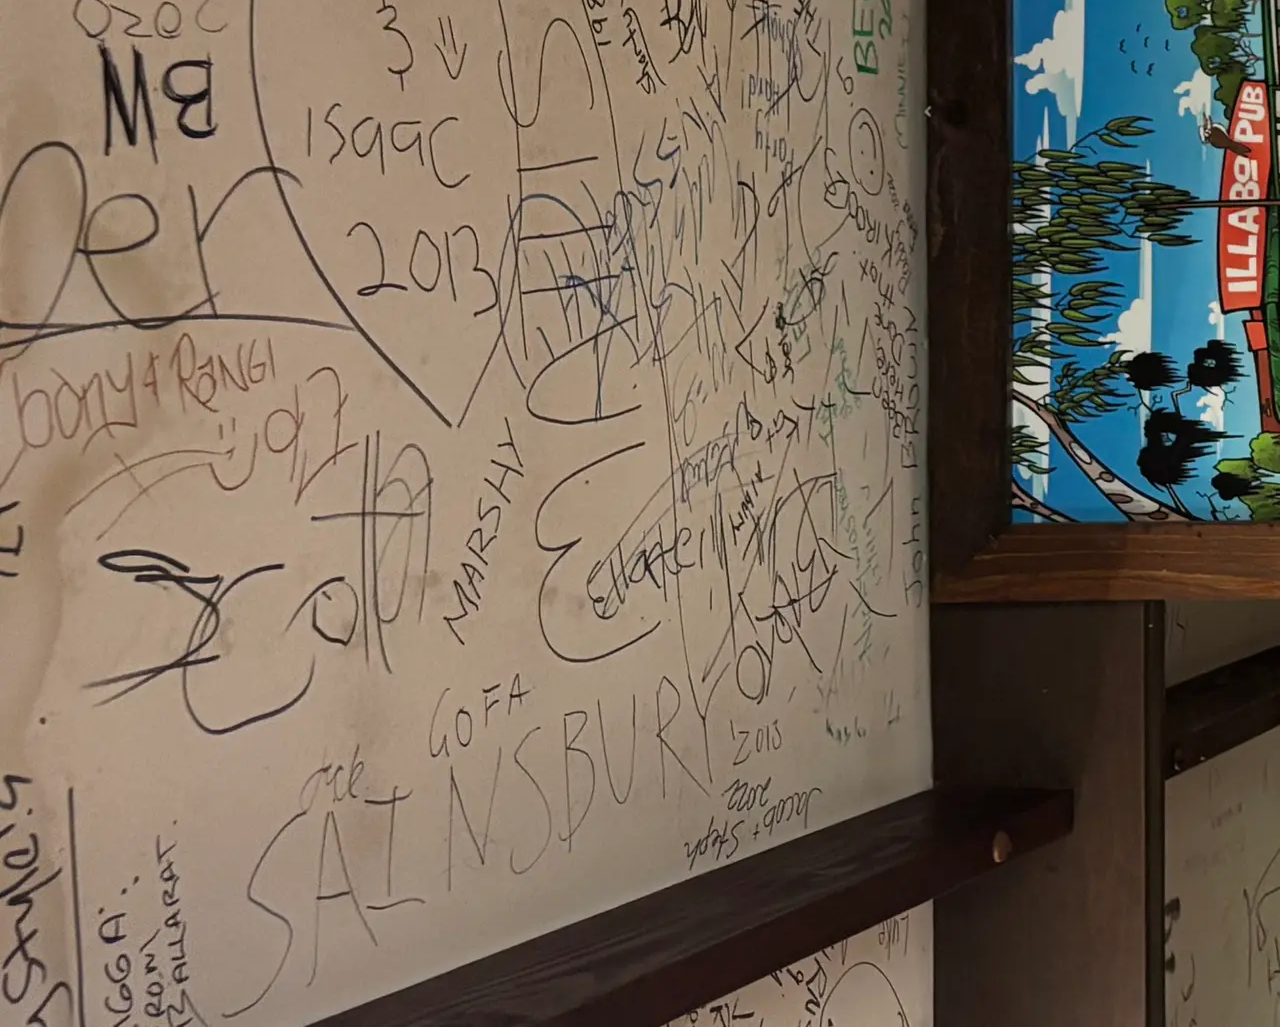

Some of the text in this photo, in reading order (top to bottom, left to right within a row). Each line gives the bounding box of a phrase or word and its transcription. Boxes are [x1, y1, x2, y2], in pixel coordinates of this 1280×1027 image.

[99, 42, 218, 164] BW
[1223, 83, 1268, 294] ILLABO PUB
[347, 221, 499, 316] 2013
[443, 416, 525, 645] MARSHY
[901, 496, 924, 608] John
